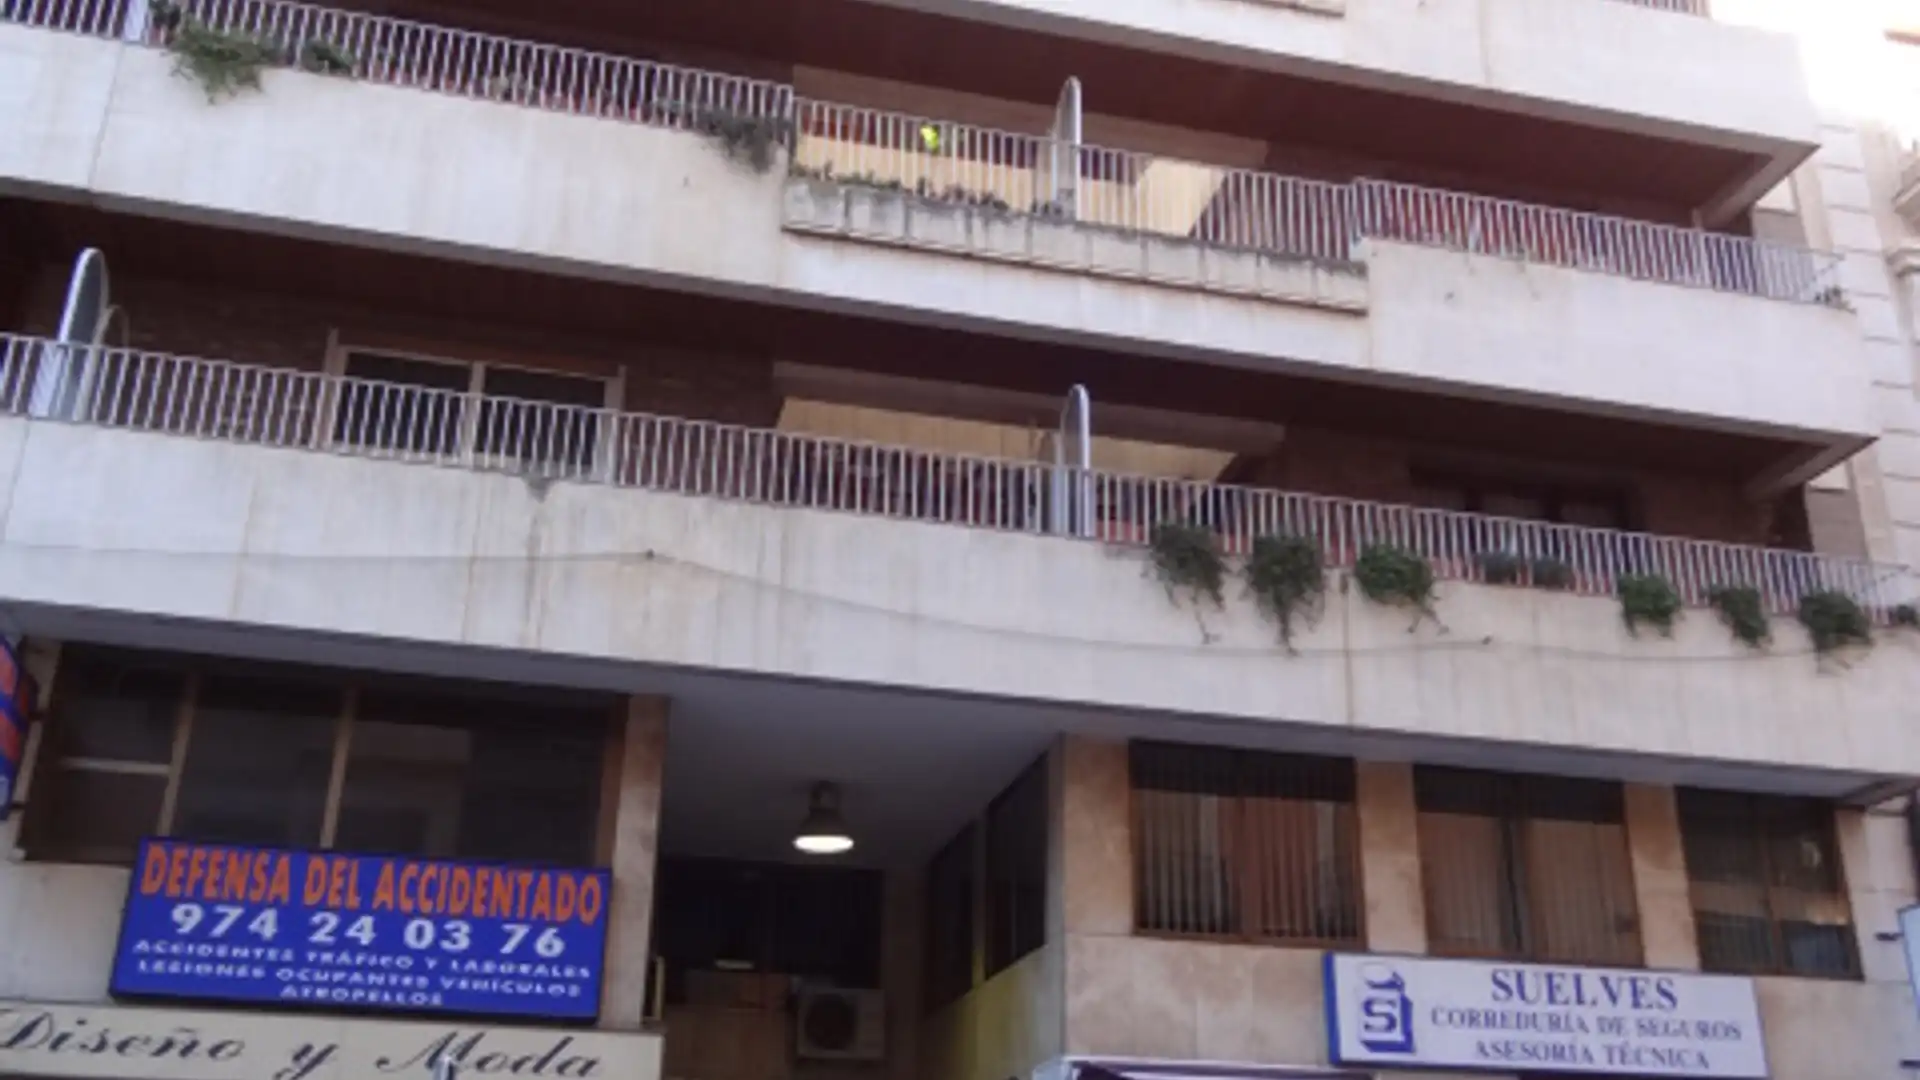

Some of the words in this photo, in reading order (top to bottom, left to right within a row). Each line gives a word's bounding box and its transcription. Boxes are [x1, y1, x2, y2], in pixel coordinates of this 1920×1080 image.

[142, 845, 290, 903] DEFENSA
[303, 856, 360, 910] DEL
[373, 861, 602, 923] ACCIDENTADO
[171, 903, 279, 941] 974
[308, 911, 376, 946] 24
[404, 918, 473, 952] 03
[500, 923, 566, 957] 76
[132, 940, 294, 962] ACCIDENTES
[306, 946, 414, 969] TRÁFICO
[426, 957, 439, 972] Y
[452, 960, 591, 979] LABORALES
[138, 959, 266, 978] LESIONES
[276, 967, 430, 989] OCUPANTES
[440, 974, 582, 998] VEHÍCULOS
[280, 985, 445, 1006] ATROPELLOS
[1491, 968, 1679, 1011] SUELVES
[1431, 1007, 1589, 1035] CORREDURÍA
[1597, 1015, 1625, 1037] DE
[1635, 1015, 1743, 1041] SEGUROS
[0, 1008, 245, 1060] Diseño
[273, 1041, 336, 1080] y
[376, 1031, 601, 1080] Moda
[1474, 1039, 1594, 1064] ASESORÍA
[1605, 1042, 1710, 1071] TÉCNICA
